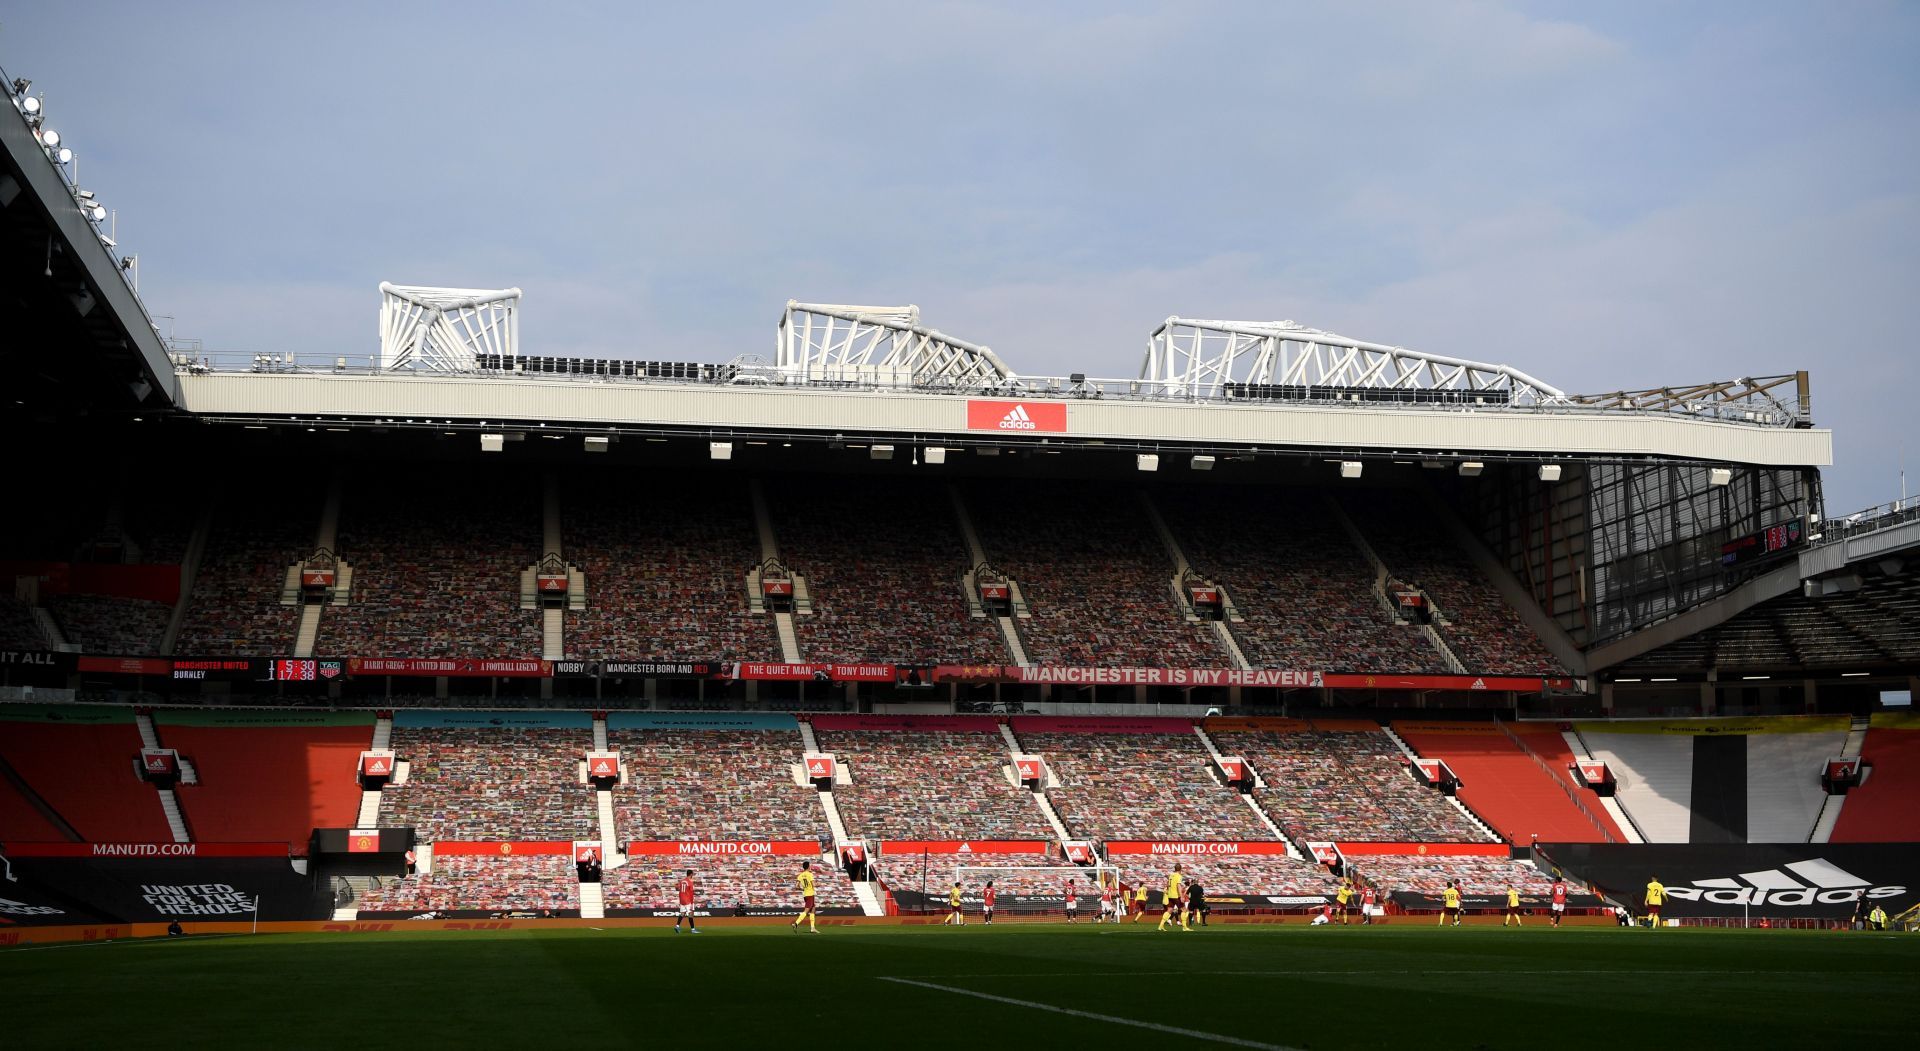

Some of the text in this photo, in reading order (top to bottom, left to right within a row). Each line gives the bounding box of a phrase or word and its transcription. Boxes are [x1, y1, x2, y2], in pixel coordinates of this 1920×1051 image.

[999, 419, 1036, 430] adidas
[22, 653, 55, 665] ALL
[173, 661, 249, 670] MANCHESTER UNITED
[364, 661, 538, 672] HARRY GREGG A UNITED HERO A FOOTBALL LEGEND
[557, 662, 585, 673] NOBBY
[606, 663, 709, 674] MANCHESTER BORN AND RED
[749, 665, 812, 676] THE QUIET MAN
[174, 670, 206, 679] BURNLEY
[836, 666, 889, 677] TONY DUNNE
[1022, 667, 1308, 685] MANCHESTER IS MY HEAVEN
[93, 843, 196, 856] MANUTD.COM
[679, 842, 772, 854] MANUTD.COM
[1151, 843, 1238, 854] MANUTD.COM
[140, 883, 235, 896] UNITED
[1556, 887, 1564, 895] 10
[1653, 888, 1659, 897] 2
[142, 891, 252, 906] FOR THE
[1662, 885, 1908, 906] adidas
[153, 901, 257, 915] HEROES
[322, 923, 394, 932] DHL
[443, 922, 513, 930] DHL
